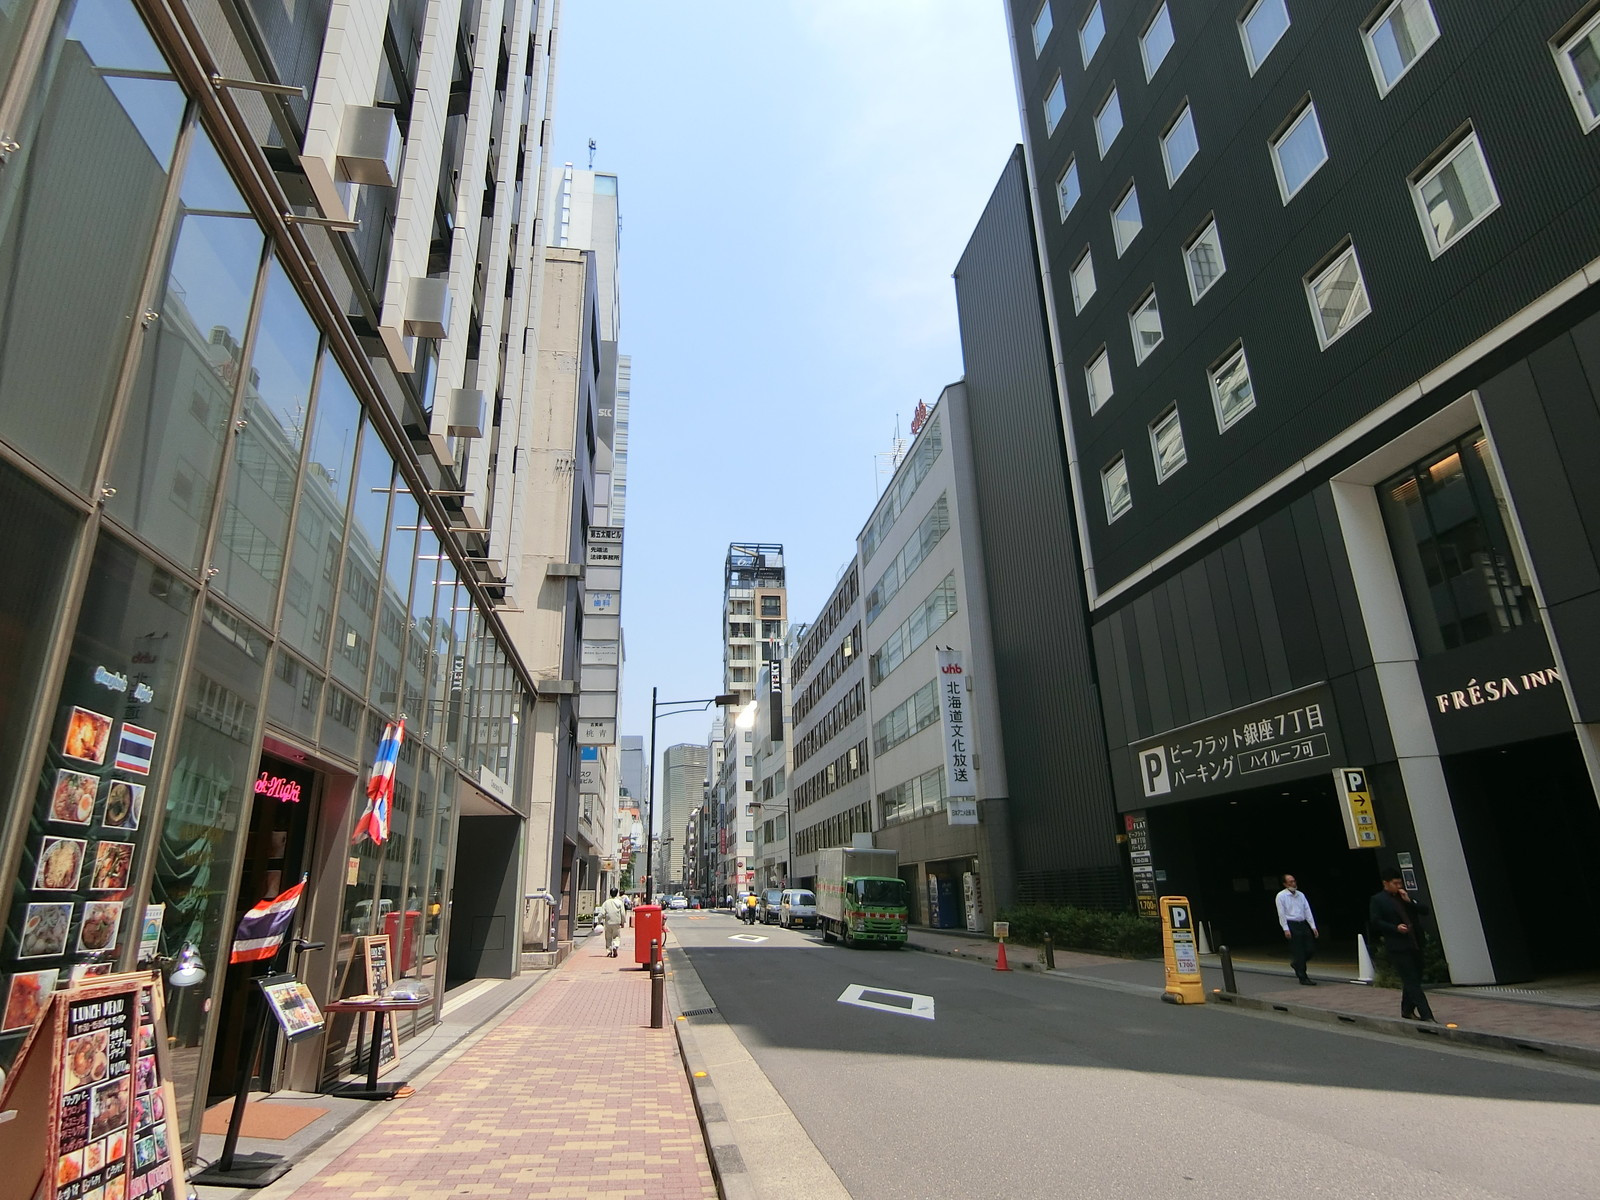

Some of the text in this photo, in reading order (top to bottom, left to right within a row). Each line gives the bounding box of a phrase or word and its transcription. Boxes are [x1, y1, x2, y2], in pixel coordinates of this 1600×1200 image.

[942, 664, 963, 675] uhb
[1435, 678, 1519, 713] FRÉSA
[947, 681, 968, 782] 北海道文化放送
[1250, 740, 1314, 768] ハイルーフ可
[1145, 752, 1162, 792] P
[1174, 755, 1234, 788] パーキング
[1348, 773, 1362, 791] P
[1133, 821, 1146, 829] FLAT
[1172, 907, 1186, 928] P
[73, 999, 124, 1022] LUNCH MENU
